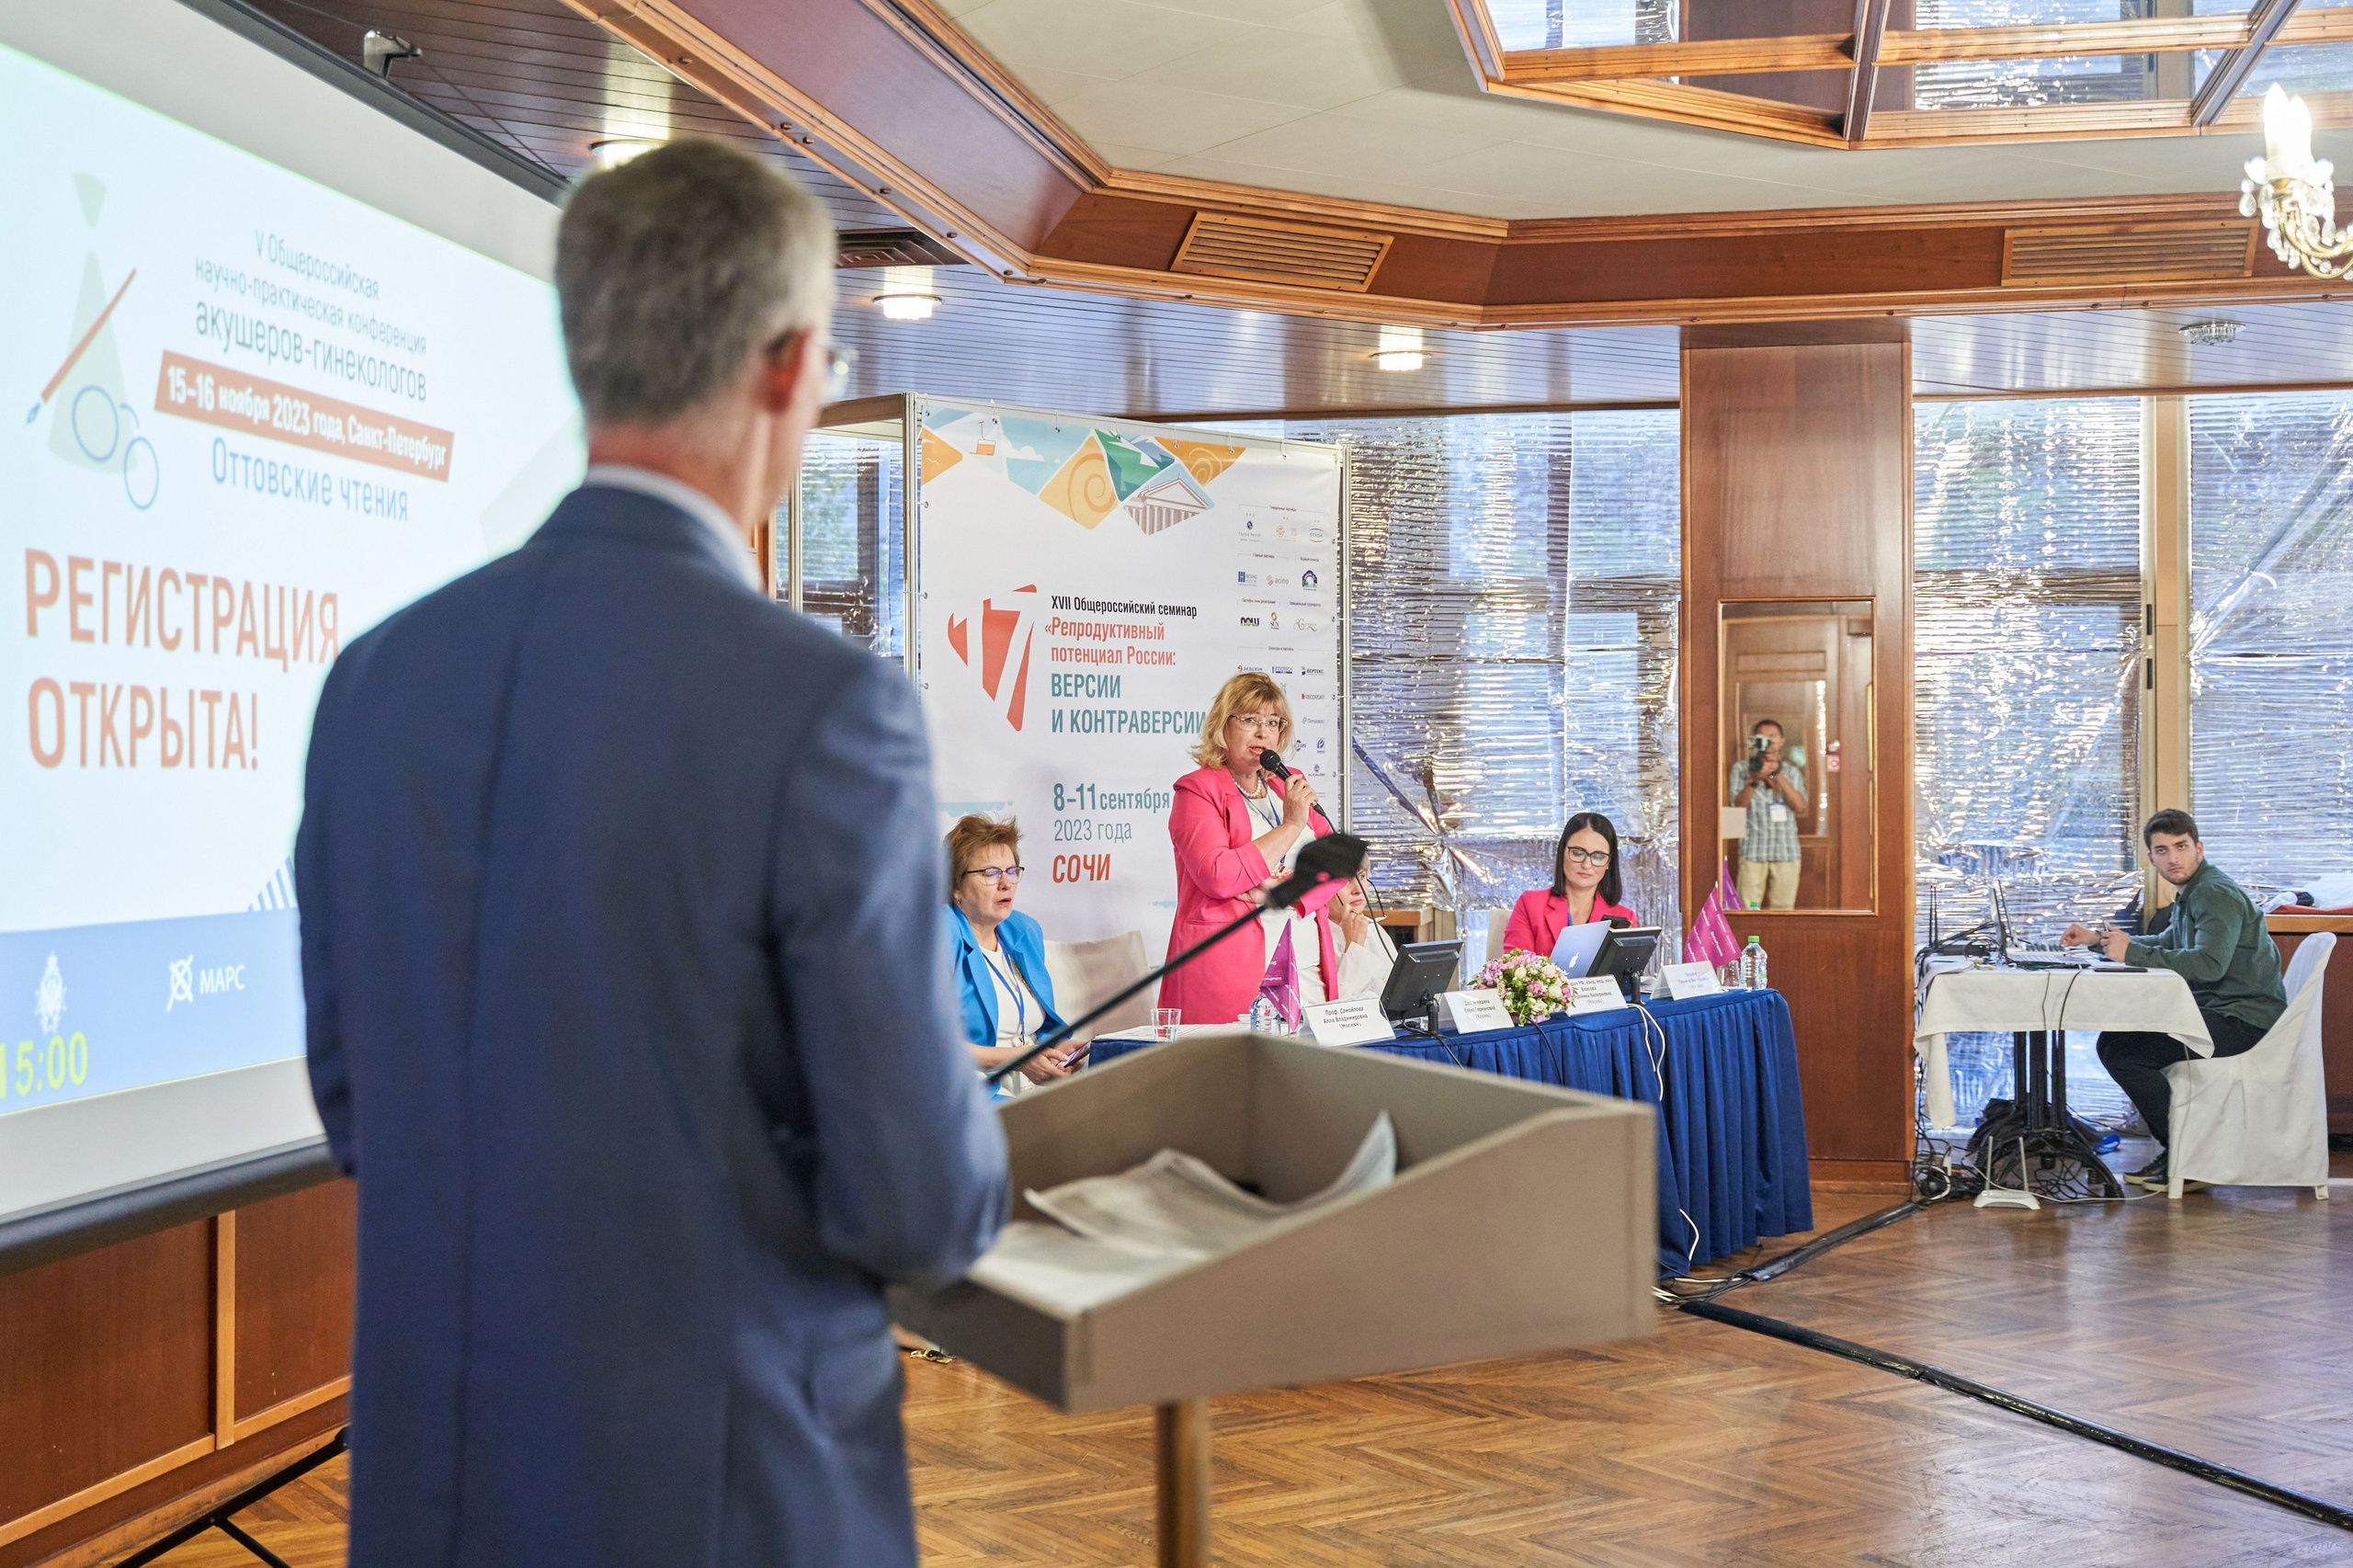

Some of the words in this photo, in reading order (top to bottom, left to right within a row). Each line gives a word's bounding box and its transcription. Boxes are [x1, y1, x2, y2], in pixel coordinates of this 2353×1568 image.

[256, 229, 264, 257] V
[268, 233, 379, 301] Общероссийская
[195, 256, 344, 328] научно-практическая
[348, 311, 426, 356] конференция
[196, 301, 426, 402] акушеров-гинекологов
[218, 384, 270, 425] ноября
[272, 393, 311, 437] 2023
[313, 411, 346, 446] года,
[347, 415, 448, 472] Санкт-Петербург
[212, 437, 333, 506] Оттовские
[340, 476, 408, 523] чтения
[25, 548, 340, 673] РЕГИСТРАЦИЯ
[1051, 596, 1072, 610] XVII
[1074, 597, 1156, 615] Общероссийский
[1158, 603, 1198, 619] семинар
[1044, 617, 1165, 642] «Репродуктивный
[1051, 646, 1123, 666] потенциал
[1127, 645, 1176, 665] России:
[1051, 673, 1121, 699] ВЕРСИИ
[28, 676, 259, 770] ОТКРЫТА!
[1051, 709, 1063, 733] И
[1070, 709, 1206, 734] КОНТРАВЕРСИИ
[1099, 788, 1170, 813] сентября
[1054, 819, 1092, 841] 2023
[1097, 823, 1132, 843] года
[1052, 853, 1110, 883] СОЧИ
[199, 965, 245, 995] МАРС
[1335, 1014, 1369, 1023] Владимировна
[1339, 1006, 1364, 1015] Самойлова
